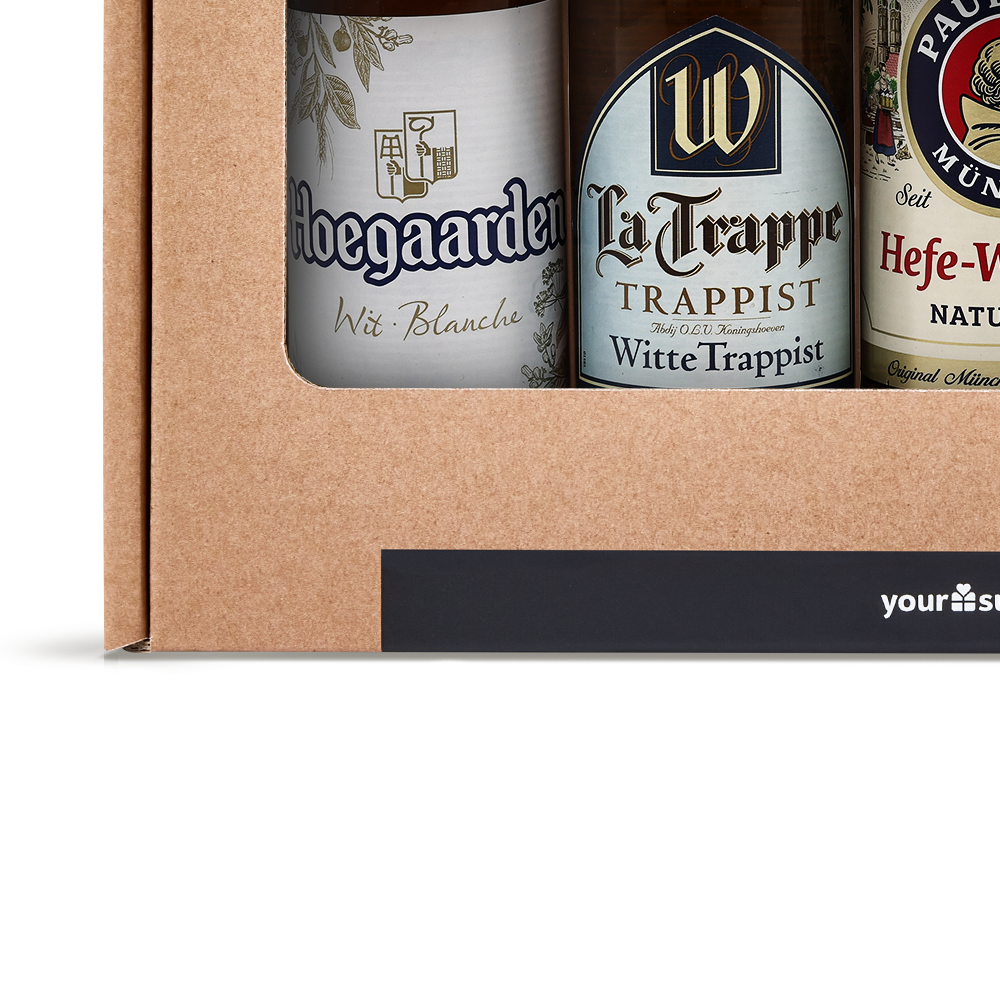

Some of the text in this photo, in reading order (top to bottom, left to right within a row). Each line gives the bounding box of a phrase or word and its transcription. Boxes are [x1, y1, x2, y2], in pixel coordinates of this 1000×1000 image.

[895, 182, 932, 210] Seit
[289, 176, 567, 286] Hoegaarden
[586, 183, 844, 277] La Trappe
[615, 277, 821, 316] TRAPPIST
[334, 296, 523, 341] Wit Blanche
[650, 322, 678, 338] Abdij
[715, 322, 785, 337] Koningshoeven
[609, 335, 697, 372] Witte
[697, 336, 824, 378] Trappist
[887, 359, 941, 383] Original
[881, 593, 949, 619] your
